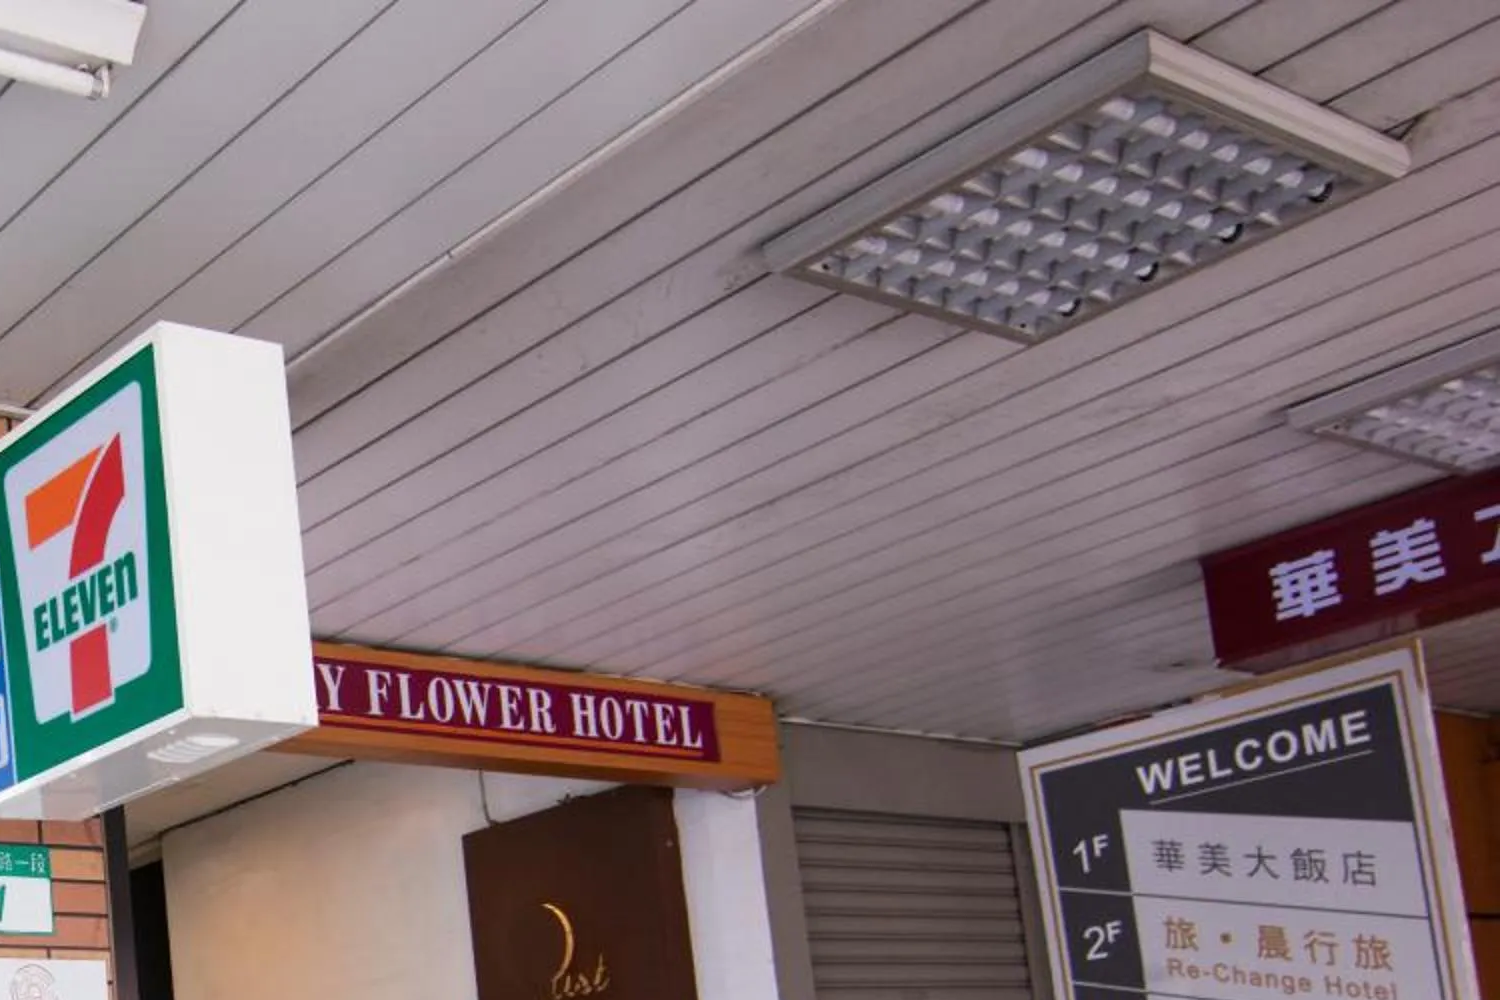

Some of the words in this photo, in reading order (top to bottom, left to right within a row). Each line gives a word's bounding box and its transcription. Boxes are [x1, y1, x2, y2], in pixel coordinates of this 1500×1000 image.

[25, 432, 125, 715] 7
[366, 669, 557, 734] FLOWER
[569, 693, 703, 748] HOTEL
[1136, 710, 1371, 795] WELCOME
[1073, 834, 1108, 873] 1F
[1152, 839, 1377, 887] 華美大飯店
[1083, 921, 1123, 961] 2F
[1166, 958, 1312, 995] Re-Change
